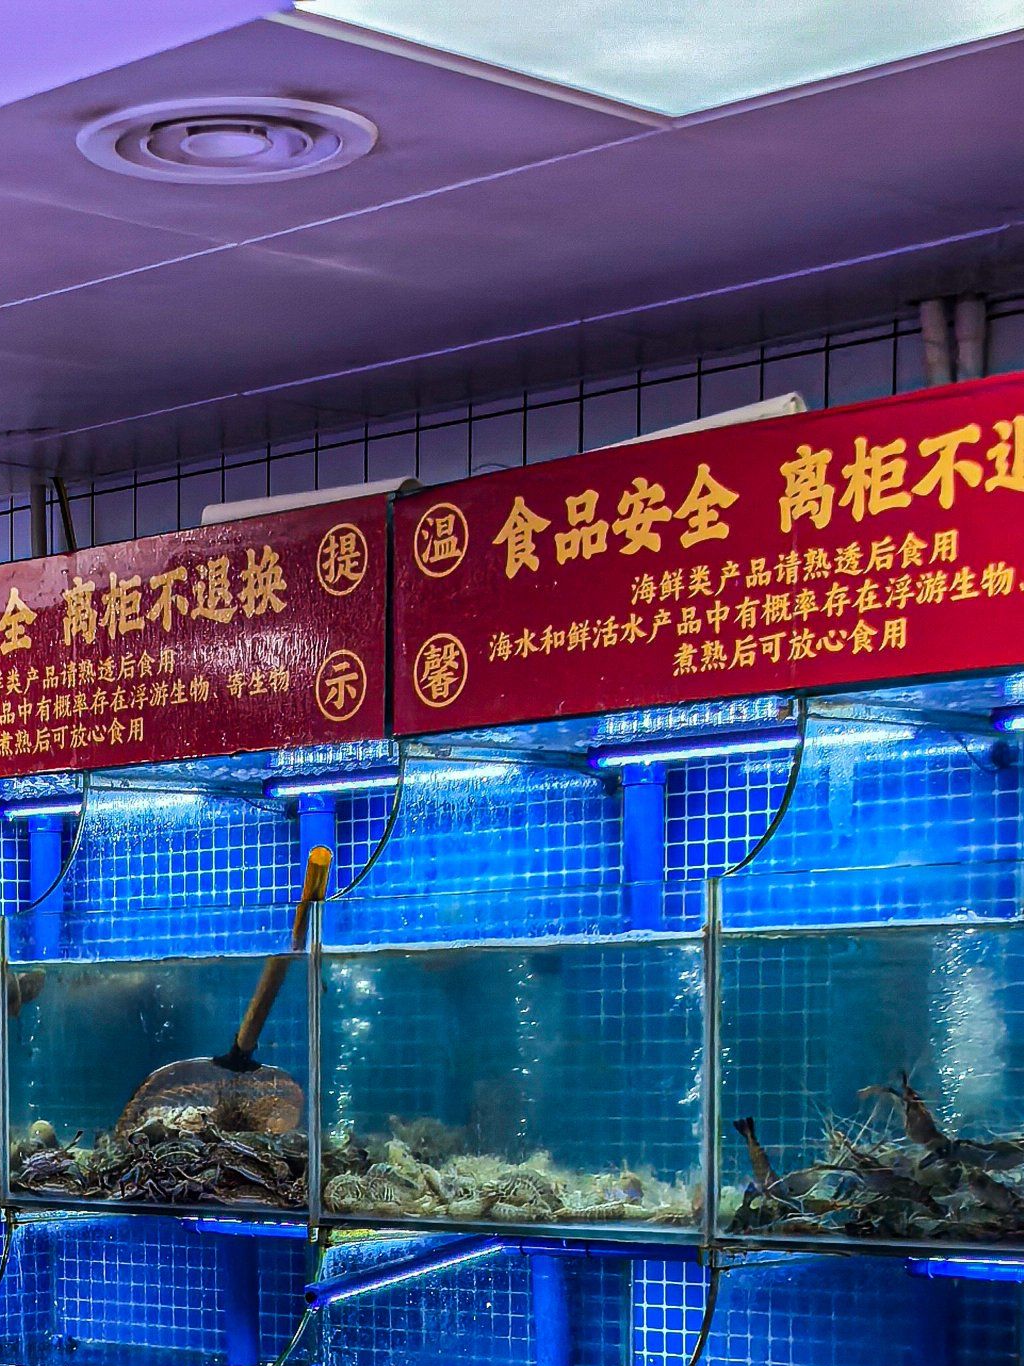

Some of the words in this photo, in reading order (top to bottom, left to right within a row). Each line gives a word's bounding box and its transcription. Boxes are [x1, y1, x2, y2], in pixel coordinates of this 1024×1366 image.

[492, 463, 740, 579] 食品安全
[61, 548, 288, 646] 离柜不退换
[631, 528, 958, 604] 海鲜类产品请熟透后食用
[671, 617, 907, 676] 煮熟后可放心食用
